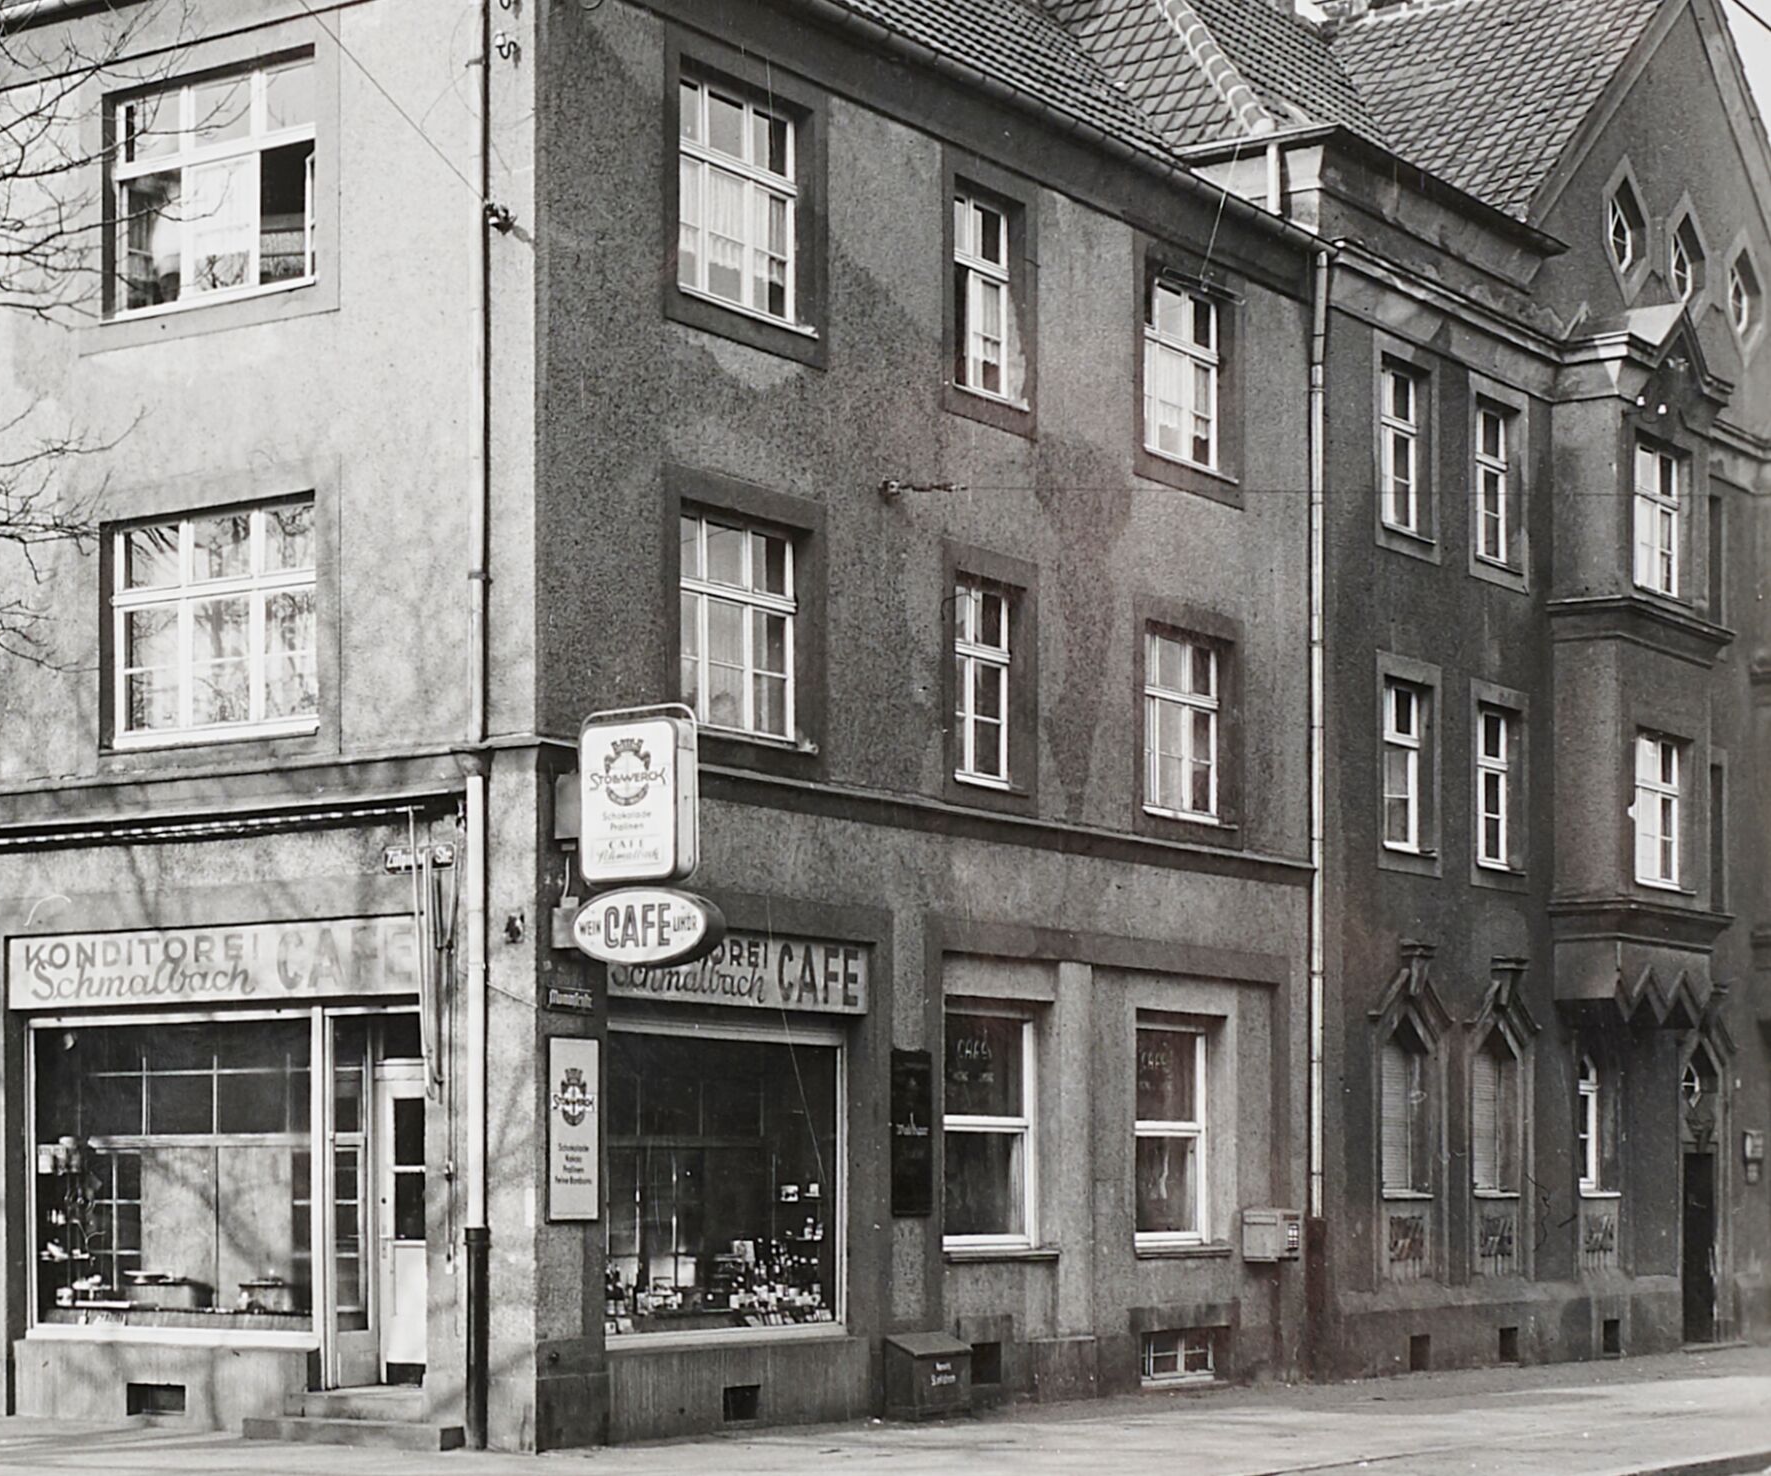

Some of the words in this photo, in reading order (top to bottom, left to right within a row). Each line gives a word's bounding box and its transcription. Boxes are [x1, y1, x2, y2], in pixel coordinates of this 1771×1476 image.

[602, 811, 652, 822] Schokolade
[610, 822, 644, 831] Pralinen
[579, 920, 601, 936] WEIN
[604, 903, 670, 948] CAFE
[25, 933, 258, 971] KONDITOREI
[277, 924, 414, 990] CAFE
[31, 955, 256, 1000] Schmalbach
[778, 942, 859, 1007] CAFE
